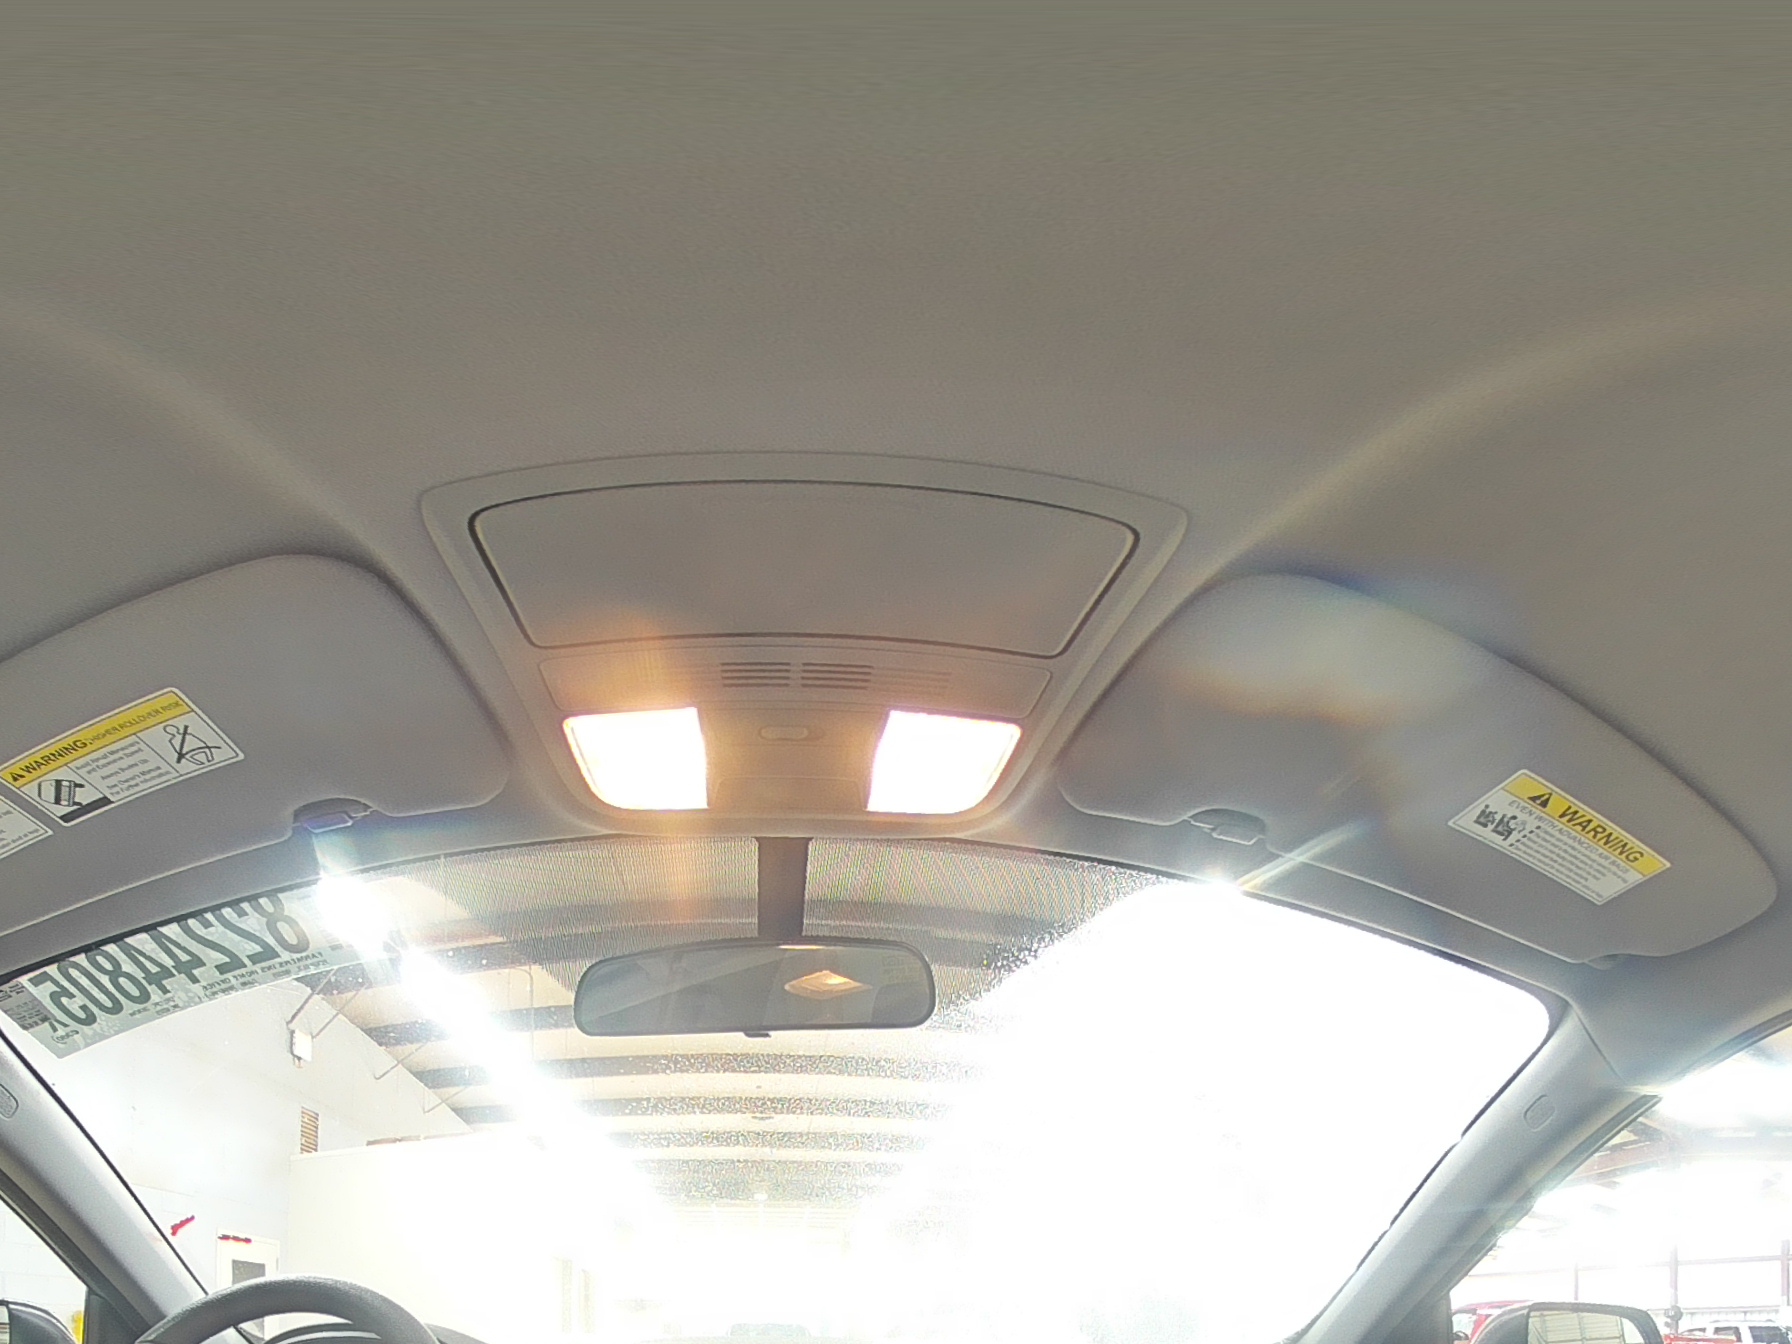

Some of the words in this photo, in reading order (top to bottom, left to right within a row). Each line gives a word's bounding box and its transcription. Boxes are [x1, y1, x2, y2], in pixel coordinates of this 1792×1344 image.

[1508, 800, 1533, 817] EVEN
[1533, 814, 1558, 831] WITH
[1558, 805, 1644, 863] WARNING
